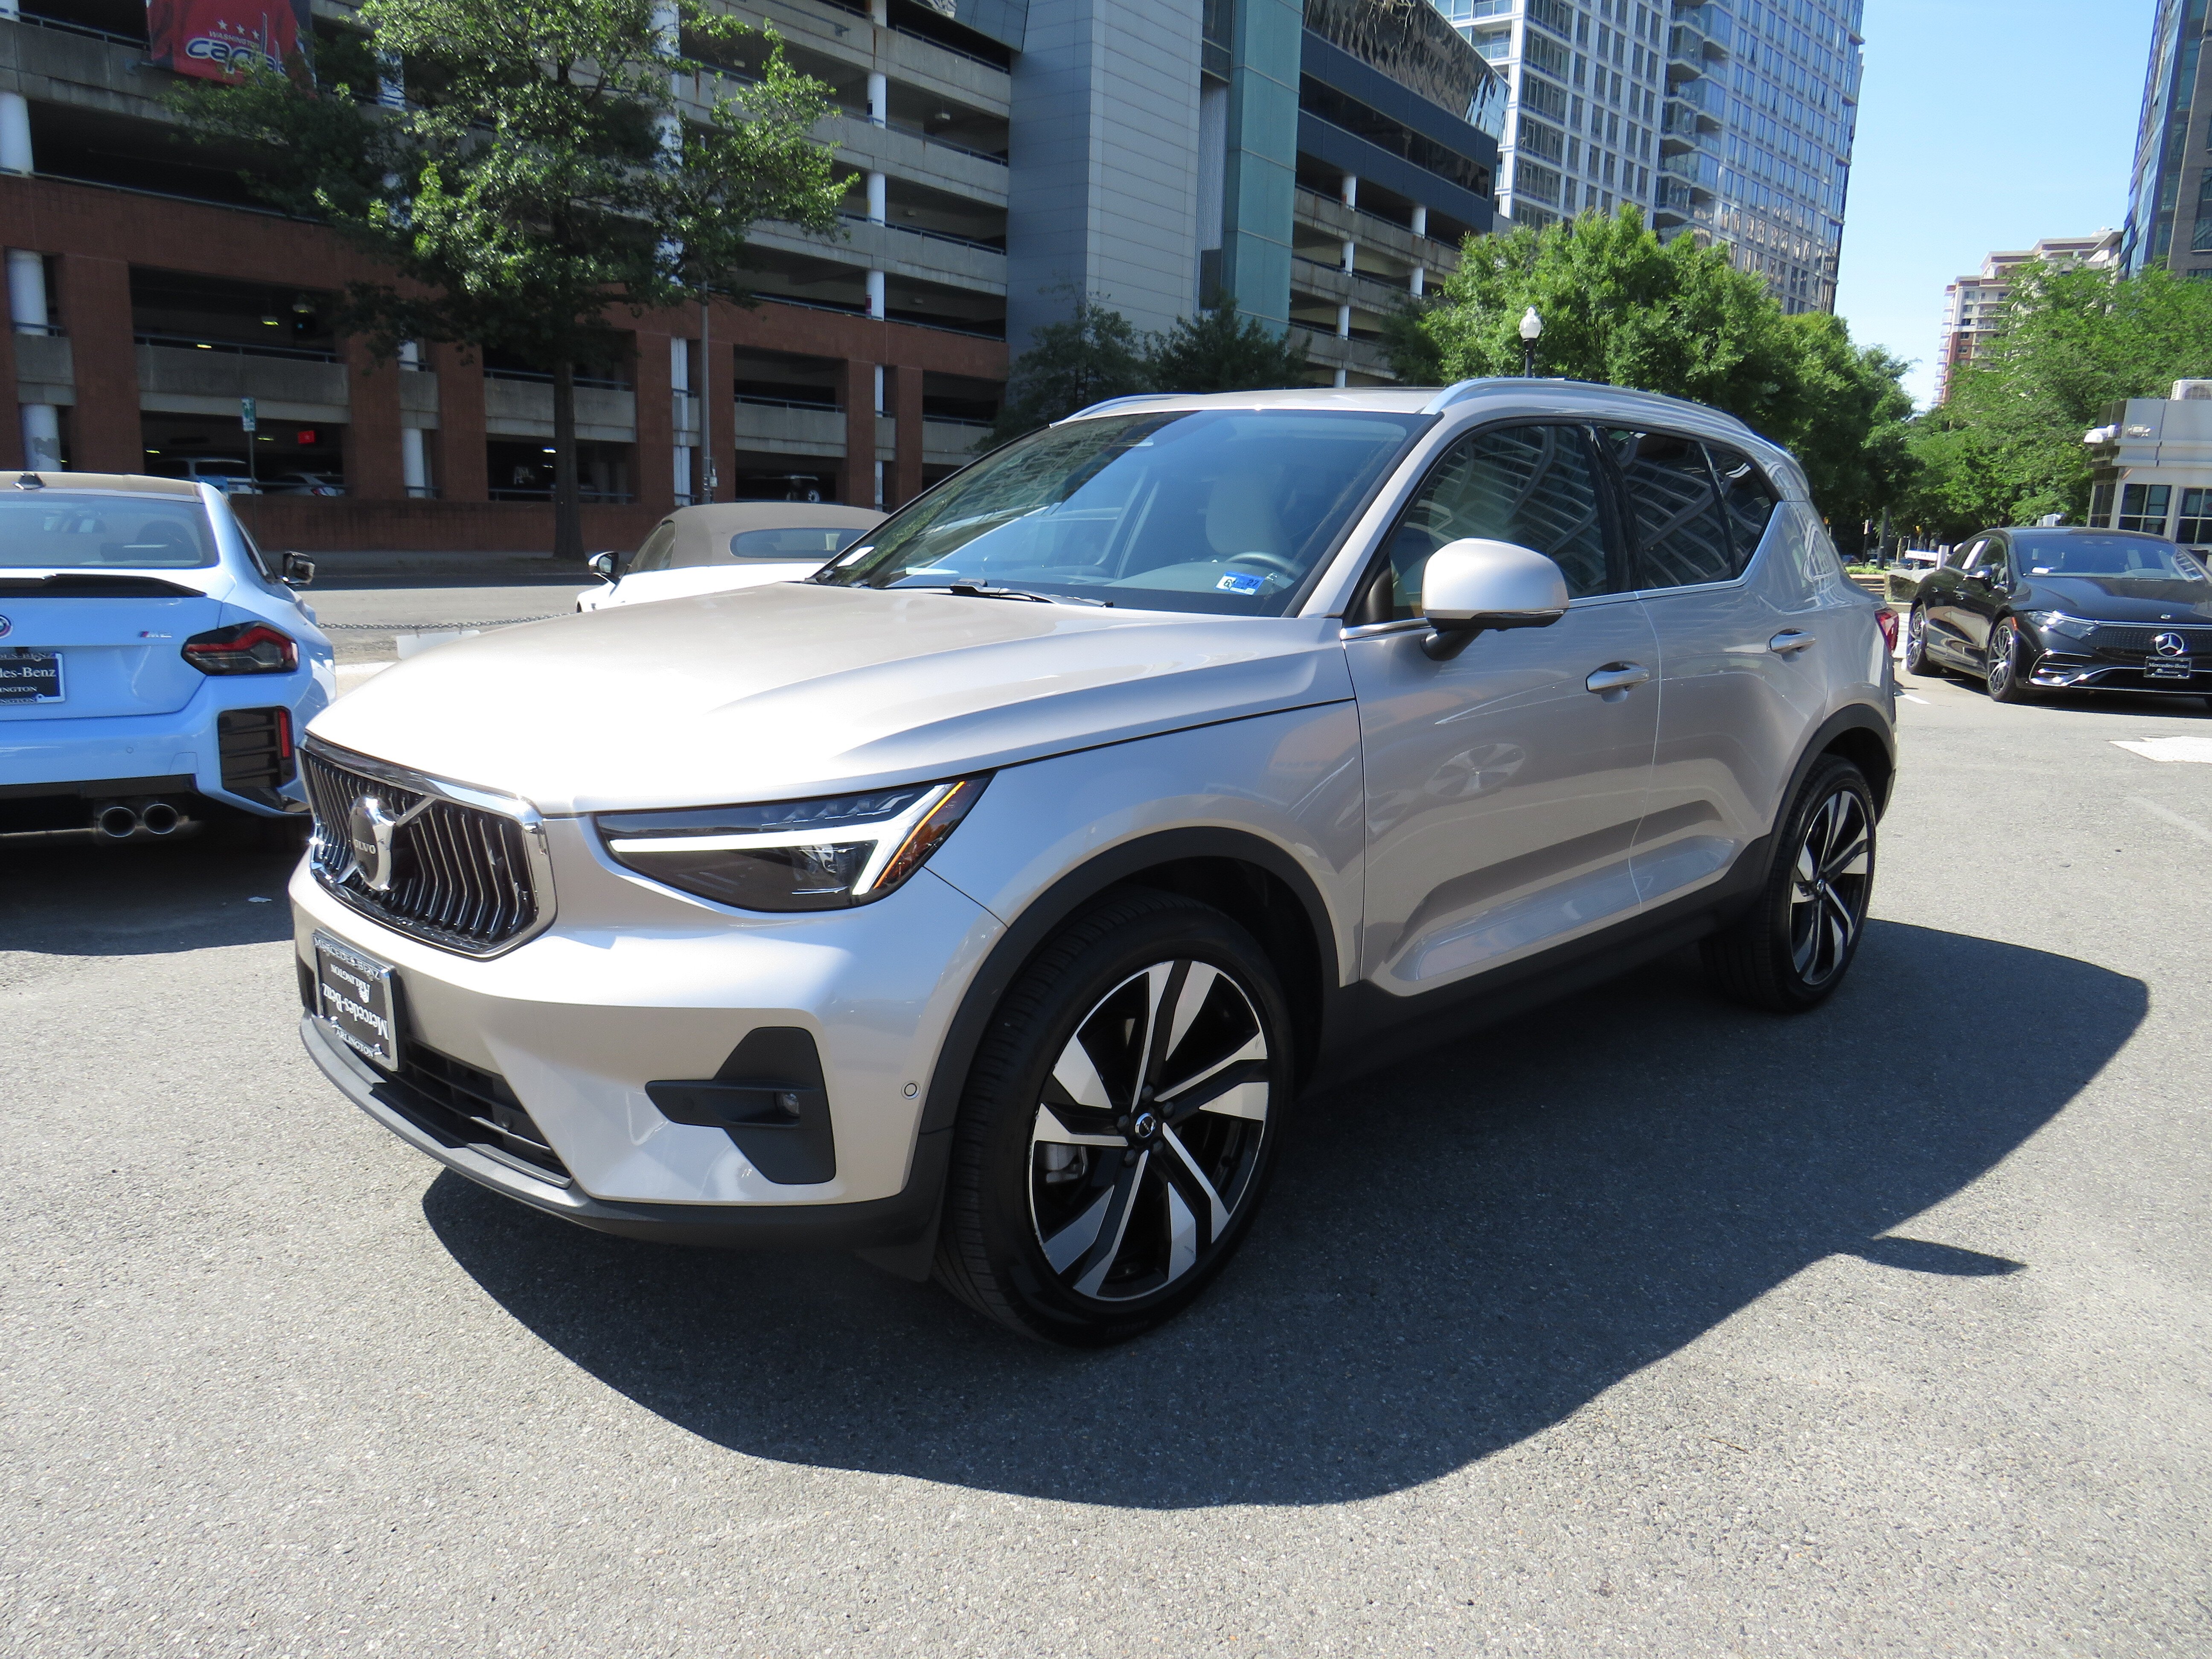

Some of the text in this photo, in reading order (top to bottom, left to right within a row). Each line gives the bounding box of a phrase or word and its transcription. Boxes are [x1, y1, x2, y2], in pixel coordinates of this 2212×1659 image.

[313, 937, 381, 981] MERCEDES-BENZ
[330, 963, 370, 1004] ARLINGTON
[322, 983, 389, 1040] Mercedes-Benz
